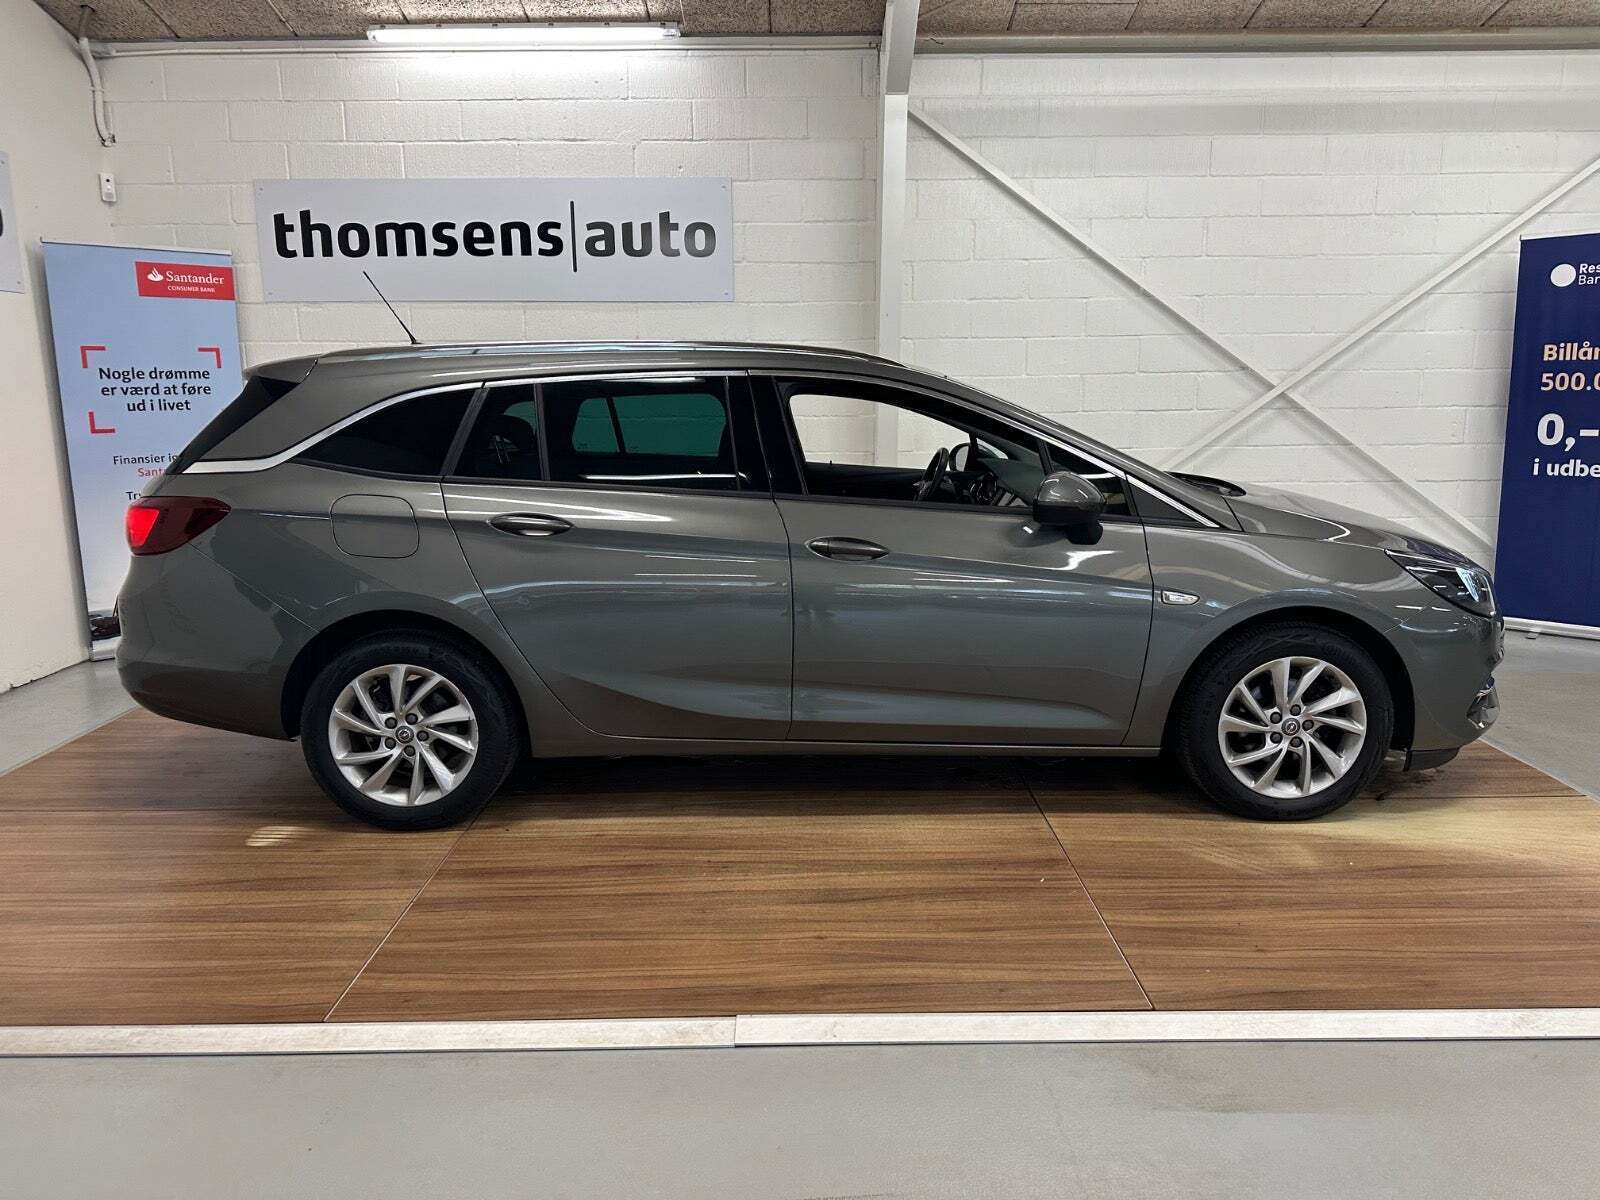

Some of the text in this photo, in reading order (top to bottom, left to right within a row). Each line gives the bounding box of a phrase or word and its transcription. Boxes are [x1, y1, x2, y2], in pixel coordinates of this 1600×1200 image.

[166, 270, 225, 285] Santander
[98, 367, 210, 382] Nogle drømme
[101, 383, 212, 396] er værd at føre
[127, 399, 191, 412] ud i livet
[113, 454, 166, 465] Finansier
[137, 467, 167, 477] Sant
[1533, 458, 1600, 478] i udbe
[125, 491, 142, 500] Tr
